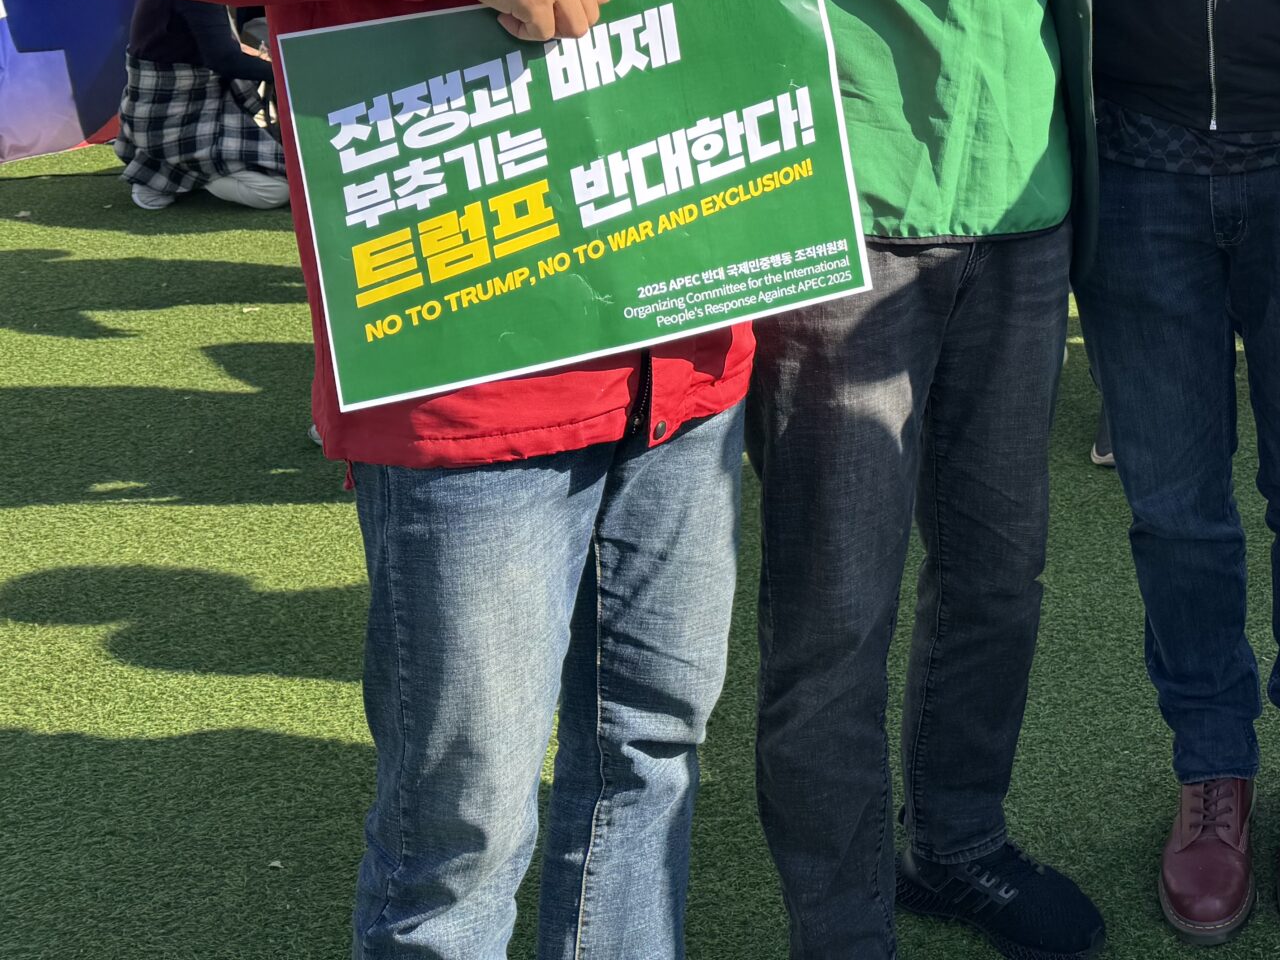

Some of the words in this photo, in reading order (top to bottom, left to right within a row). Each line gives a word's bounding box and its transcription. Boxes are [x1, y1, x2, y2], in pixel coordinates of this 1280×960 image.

[327, 50, 534, 174] 전쟁과
[543, 2, 681, 101] 배제
[343, 128, 549, 229] 부추기는
[352, 178, 560, 309] 트럼프
[569, 86, 816, 229] 반대한다!
[364, 314, 403, 342] NO
[405, 300, 442, 327] TO
[444, 267, 537, 312] TRUMP,
[538, 252, 572, 279] NO
[572, 239, 605, 265] TO
[606, 220, 655, 252] WAR
[657, 203, 699, 234] AND
[700, 158, 814, 217] EXCLUSION!
[623, 297, 686, 319] Organizing
[686, 282, 747, 304] Committee
[747, 276, 762, 289] for
[763, 272, 783, 286] the
[783, 255, 851, 281] International
[637, 281, 668, 298] 2025
[668, 274, 702, 291] APEC
[701, 266, 726, 284] 반대
[726, 251, 793, 277] 국제민중행동
[794, 238, 849, 262] 조직위원회
[656, 306, 704, 328] People's
[704, 295, 758, 315] Response
[758, 285, 799, 304] Against
[798, 276, 826, 293] APEC
[827, 270, 853, 286] 2025
